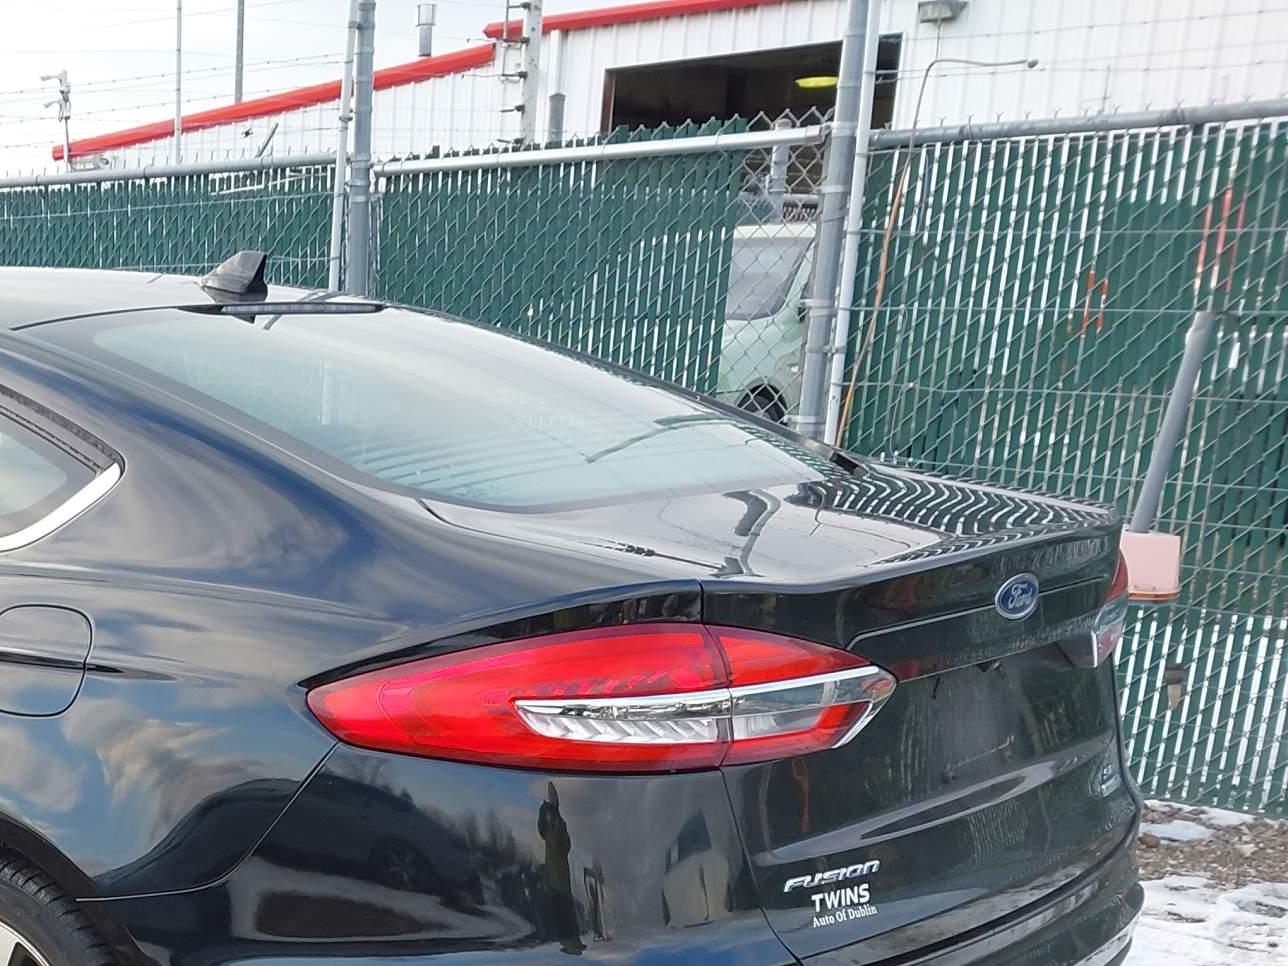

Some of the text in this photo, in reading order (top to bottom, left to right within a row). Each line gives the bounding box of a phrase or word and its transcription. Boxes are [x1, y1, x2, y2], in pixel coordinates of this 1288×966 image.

[1007, 583, 1033, 609] Ford
[783, 860, 880, 892] FUSION
[811, 883, 870, 912] TWINS
[813, 904, 878, 928] Auto Of Dublin
